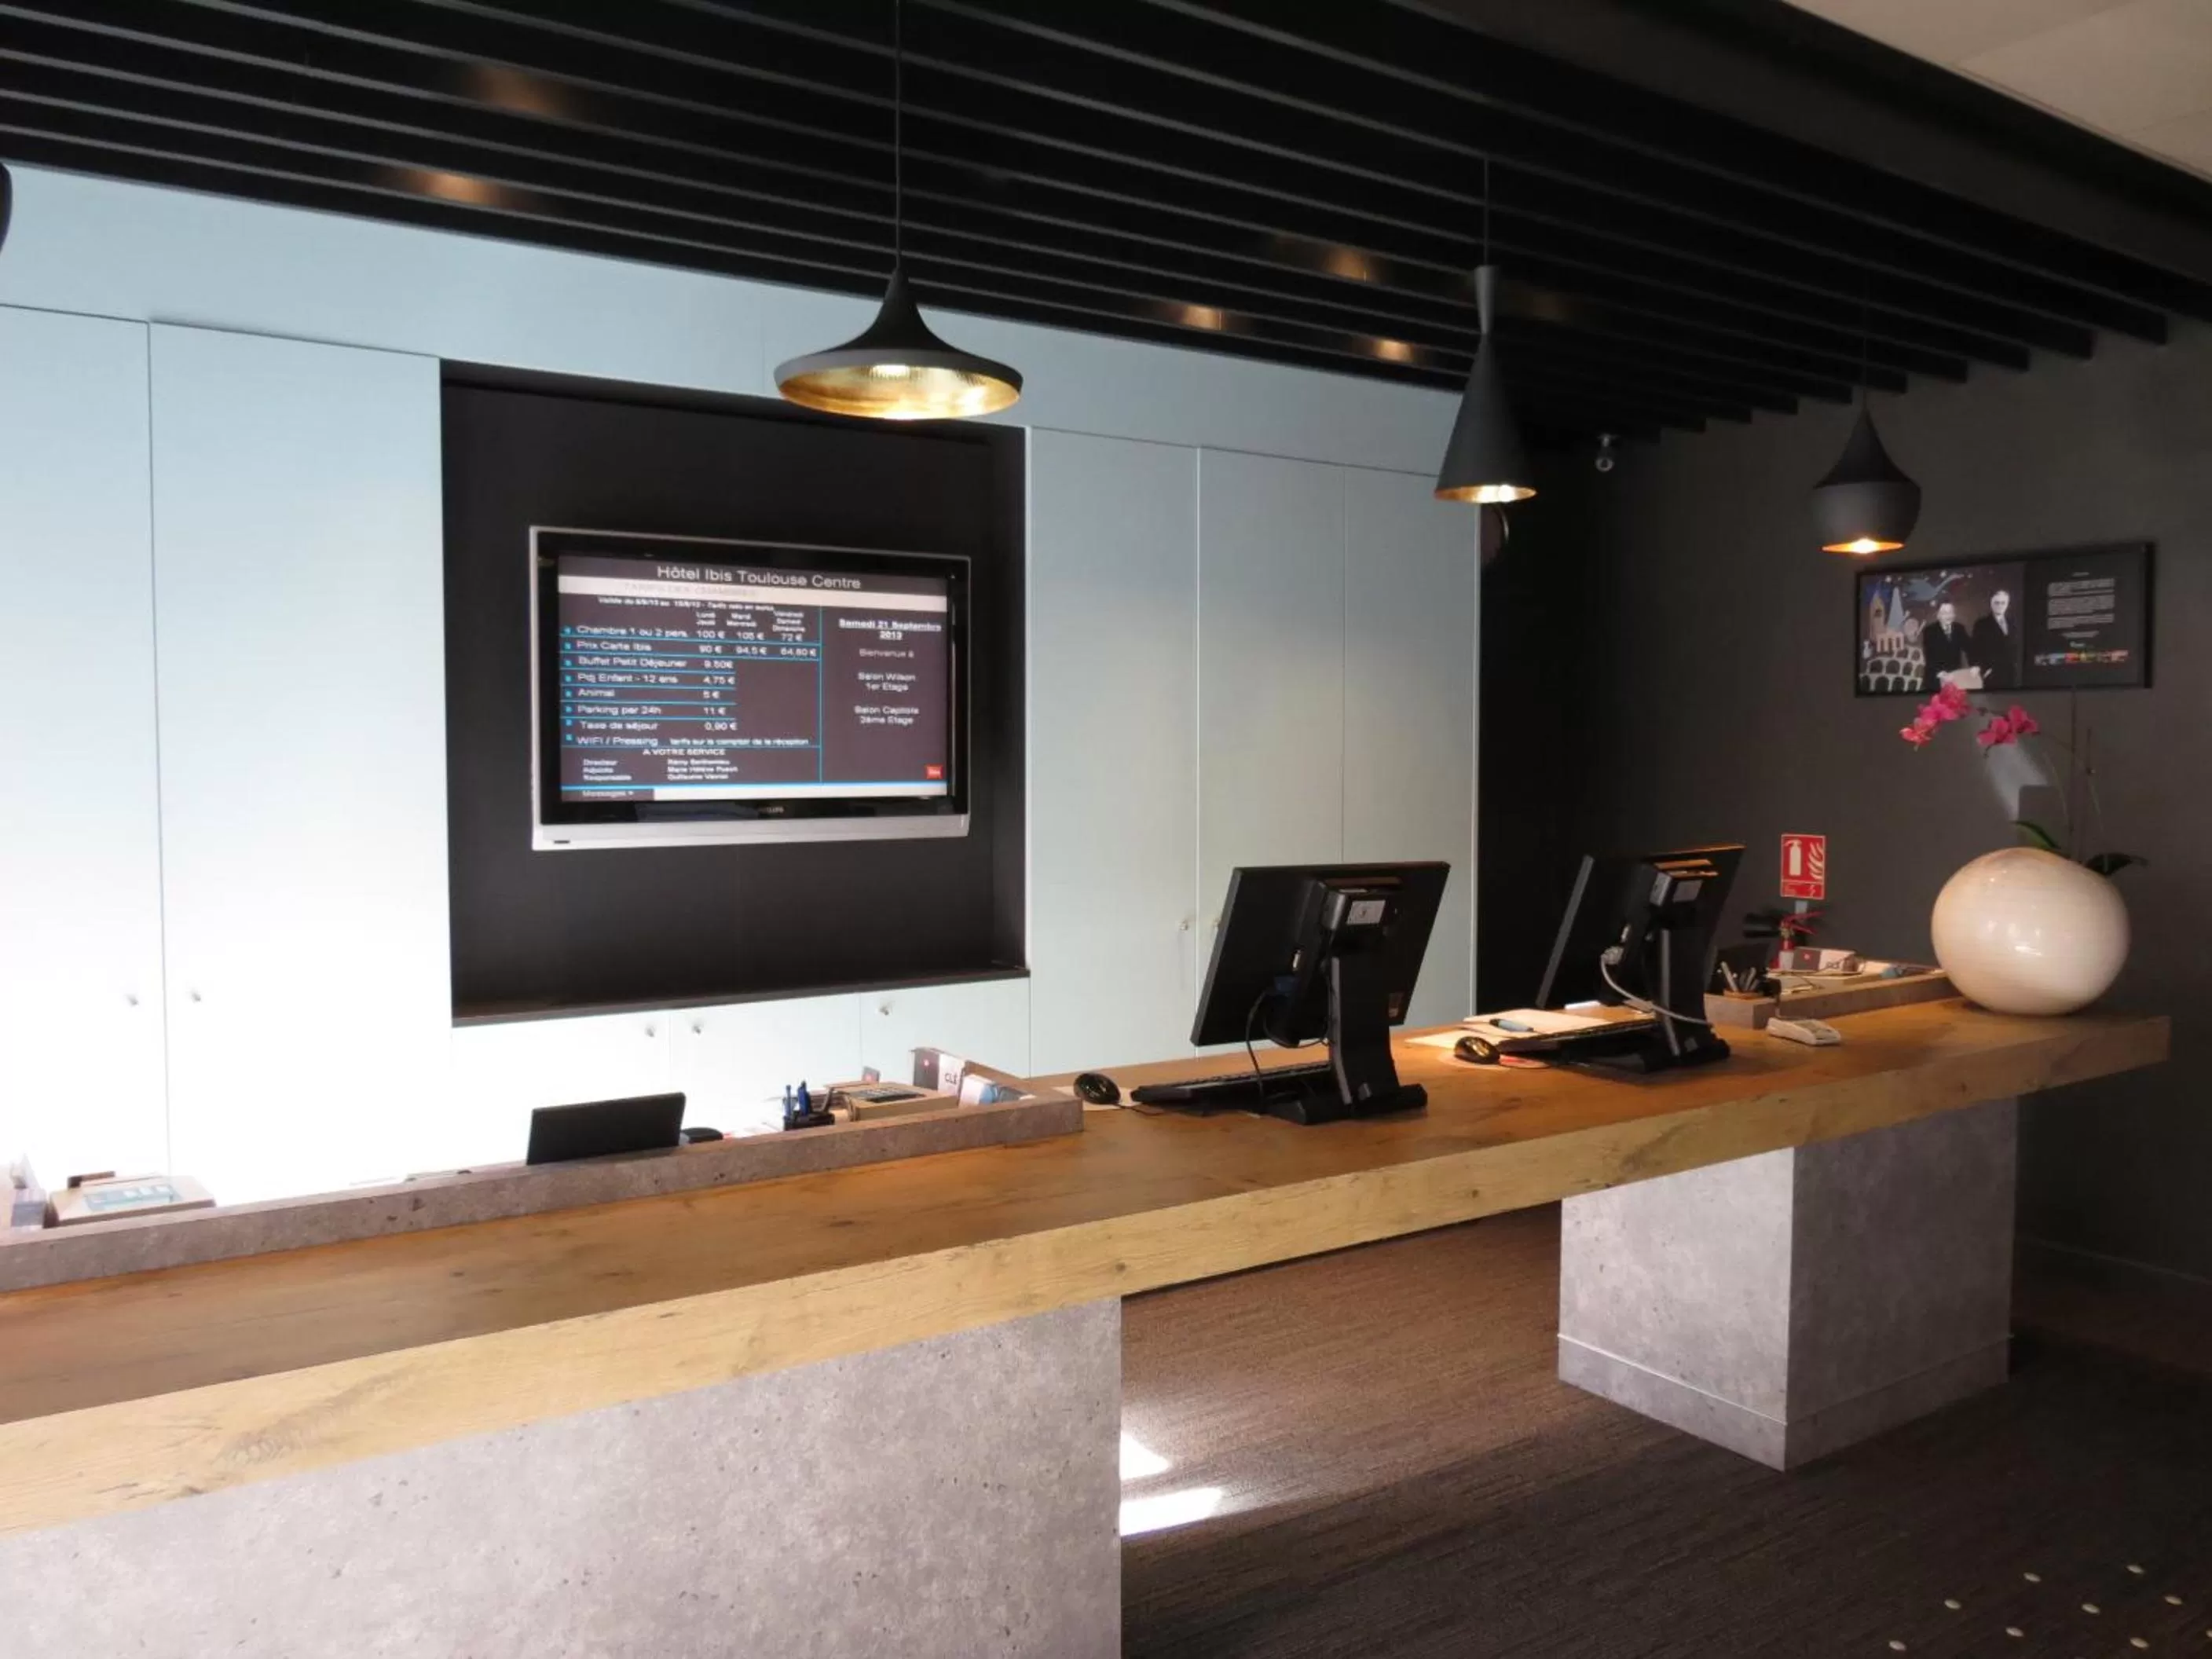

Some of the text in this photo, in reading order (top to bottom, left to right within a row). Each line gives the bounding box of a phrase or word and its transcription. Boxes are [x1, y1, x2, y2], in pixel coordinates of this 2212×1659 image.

[657, 565, 861, 589] Hôtel Ibis Toulouse Centre
[838, 617, 876, 629] Samedi
[891, 621, 942, 632] Septembre
[576, 626, 626, 635] Chambre
[655, 628, 664, 637] 2
[736, 632, 765, 640] 105 €
[781, 633, 803, 642] 72 €
[577, 640, 599, 650] Prix
[600, 642, 631, 651] Carte
[699, 645, 723, 654] 90 €
[759, 646, 767, 655] €
[809, 648, 817, 657] €
[859, 648, 906, 657] Bienvenue
[578, 657, 687, 668] Buffet Petit Déjeuner
[598, 674, 632, 683] Enfant
[643, 675, 656, 683] 12
[727, 676, 735, 685] €
[858, 672, 916, 681] Salon Wilson
[577, 688, 615, 698] Animal
[702, 690, 720, 699] 5 €
[577, 705, 619, 716] Parking
[641, 705, 661, 715] 24h
[854, 705, 881, 714] Salon
[626, 722, 659, 731] séjour
[729, 722, 738, 731] €
[613, 736, 659, 747] Pressing
